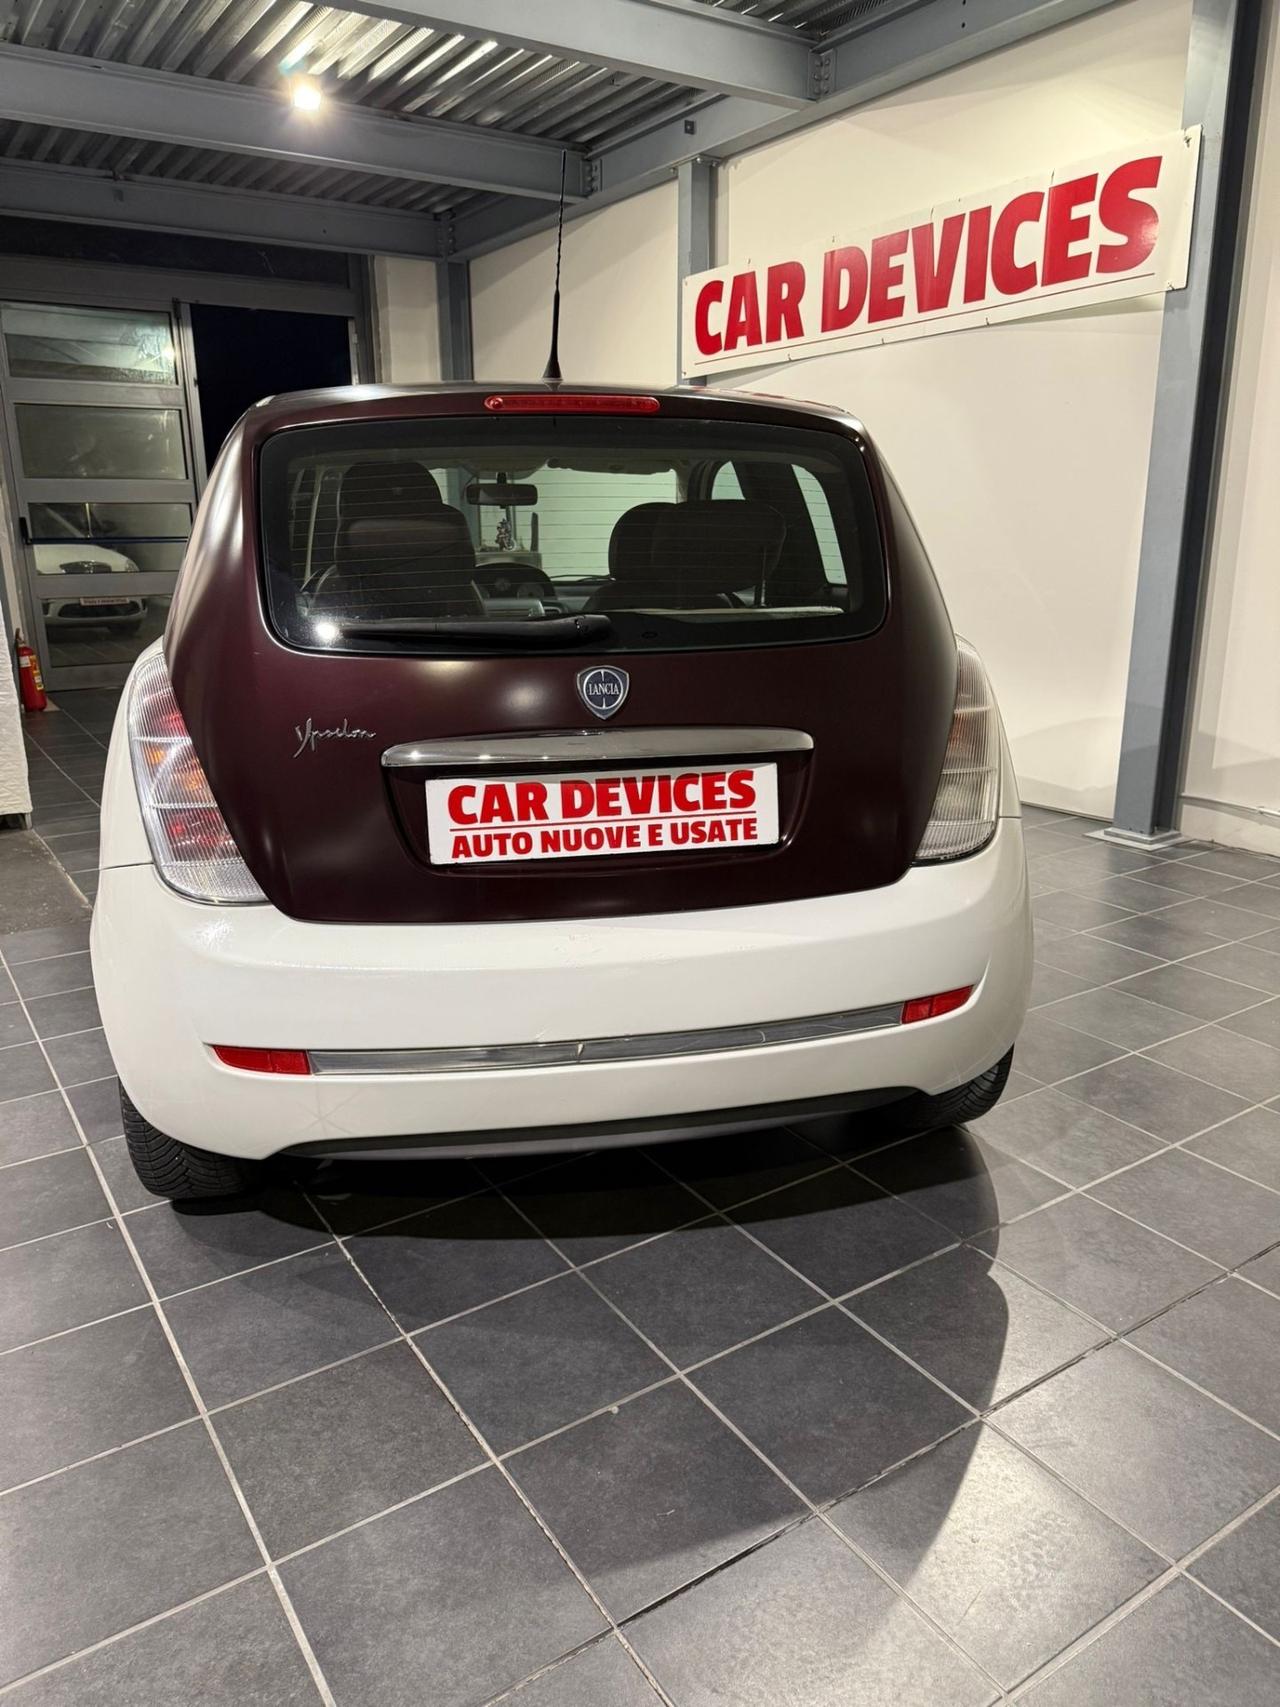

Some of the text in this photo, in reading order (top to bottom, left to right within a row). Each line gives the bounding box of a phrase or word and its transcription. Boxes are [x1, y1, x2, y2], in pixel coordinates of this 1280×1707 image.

[694, 156, 1162, 356] CAR DEVICES
[588, 682, 620, 696] LANCIA
[447, 769, 756, 825] CAR DEVICES
[452, 817, 758, 859] AUTO NUOVE E USATE
